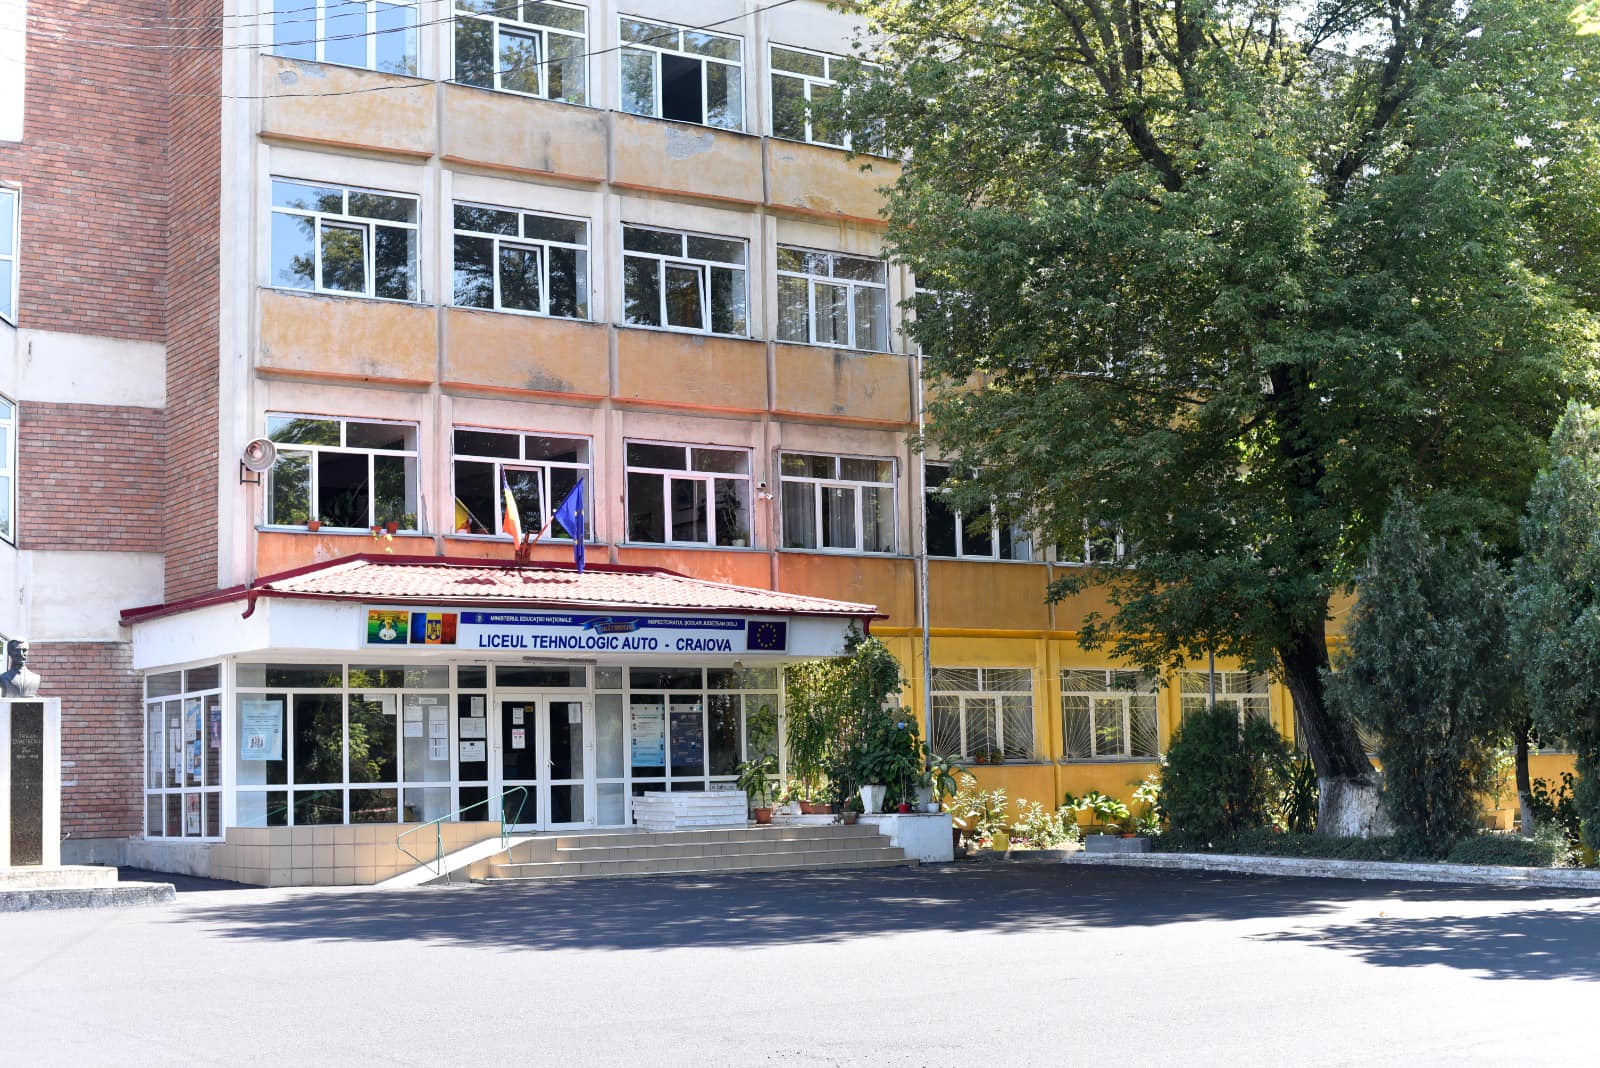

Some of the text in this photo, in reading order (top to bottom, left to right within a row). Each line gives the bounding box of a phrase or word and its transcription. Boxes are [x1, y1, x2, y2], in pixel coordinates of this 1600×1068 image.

[479, 634, 528, 648] LICEUL
[531, 635, 618, 649] TEHNOLOGIC
[622, 637, 658, 650] AUTO
[676, 638, 732, 651] CRAIOVA
